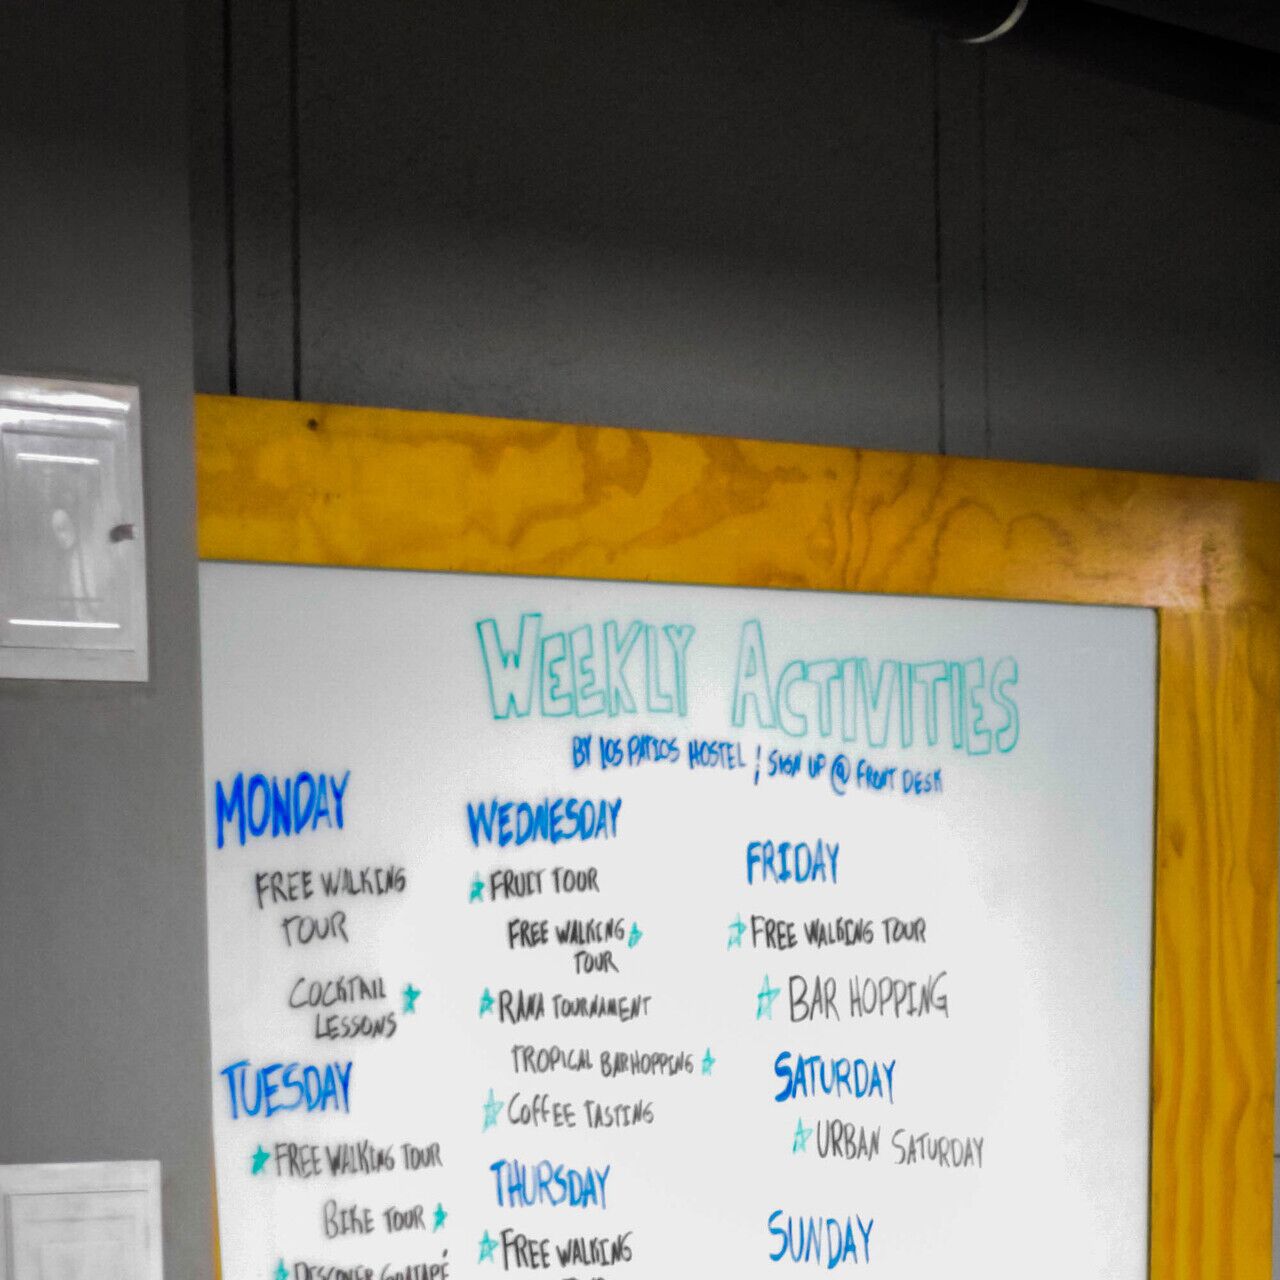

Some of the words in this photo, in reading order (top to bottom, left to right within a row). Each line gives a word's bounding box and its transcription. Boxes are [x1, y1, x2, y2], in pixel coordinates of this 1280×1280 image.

[476, 613, 695, 719] WEEKLY
[732, 619, 1020, 755] ACTIVITIES
[572, 734, 591, 768] BY
[688, 740, 746, 770] HOSTEL
[809, 753, 826, 778] UP
[831, 754, 850, 795] @
[902, 768, 942, 794] DESK
[215, 770, 350, 849] MONDAY
[467, 798, 621, 848] WEDNESDAY
[746, 838, 839, 885] FRIDAY
[255, 871, 313, 909] FREE
[321, 865, 406, 897] WALKING
[490, 869, 543, 901] FRUIT
[553, 867, 600, 893] TOUR
[282, 911, 349, 946] TOUR
[508, 919, 549, 948] FREE
[556, 919, 624, 944] WALKING
[751, 914, 798, 950] FREE
[804, 916, 874, 949] WALKING
[881, 917, 926, 944] TOUR
[573, 950, 619, 974] TOUR
[289, 975, 386, 1009] COCKTAIL
[552, 994, 652, 1022] TOURNAMENT
[789, 975, 840, 1022] BAR
[849, 970, 949, 1018] HOPPING
[315, 1012, 397, 1040] LESSONS
[511, 1044, 592, 1074] TROPICAL
[774, 1051, 895, 1105] SATURDAY
[220, 1060, 352, 1120] TUESDAY
[507, 1092, 575, 1128] COFFEE
[584, 1098, 654, 1129] TASTING
[274, 1142, 322, 1178] FREE
[325, 1140, 395, 1176] WALKING
[401, 1142, 443, 1170] TOUR
[817, 1119, 881, 1162] URBAN
[892, 1128, 984, 1168] SATURDAY
[489, 1159, 611, 1210] THURSDAY
[322, 1199, 375, 1239] BIKE
[384, 1205, 425, 1233] TOUR
[767, 1209, 874, 1269] SUNDAY
[500, 1228, 550, 1271] FREE
[556, 1231, 633, 1267] WALKING
